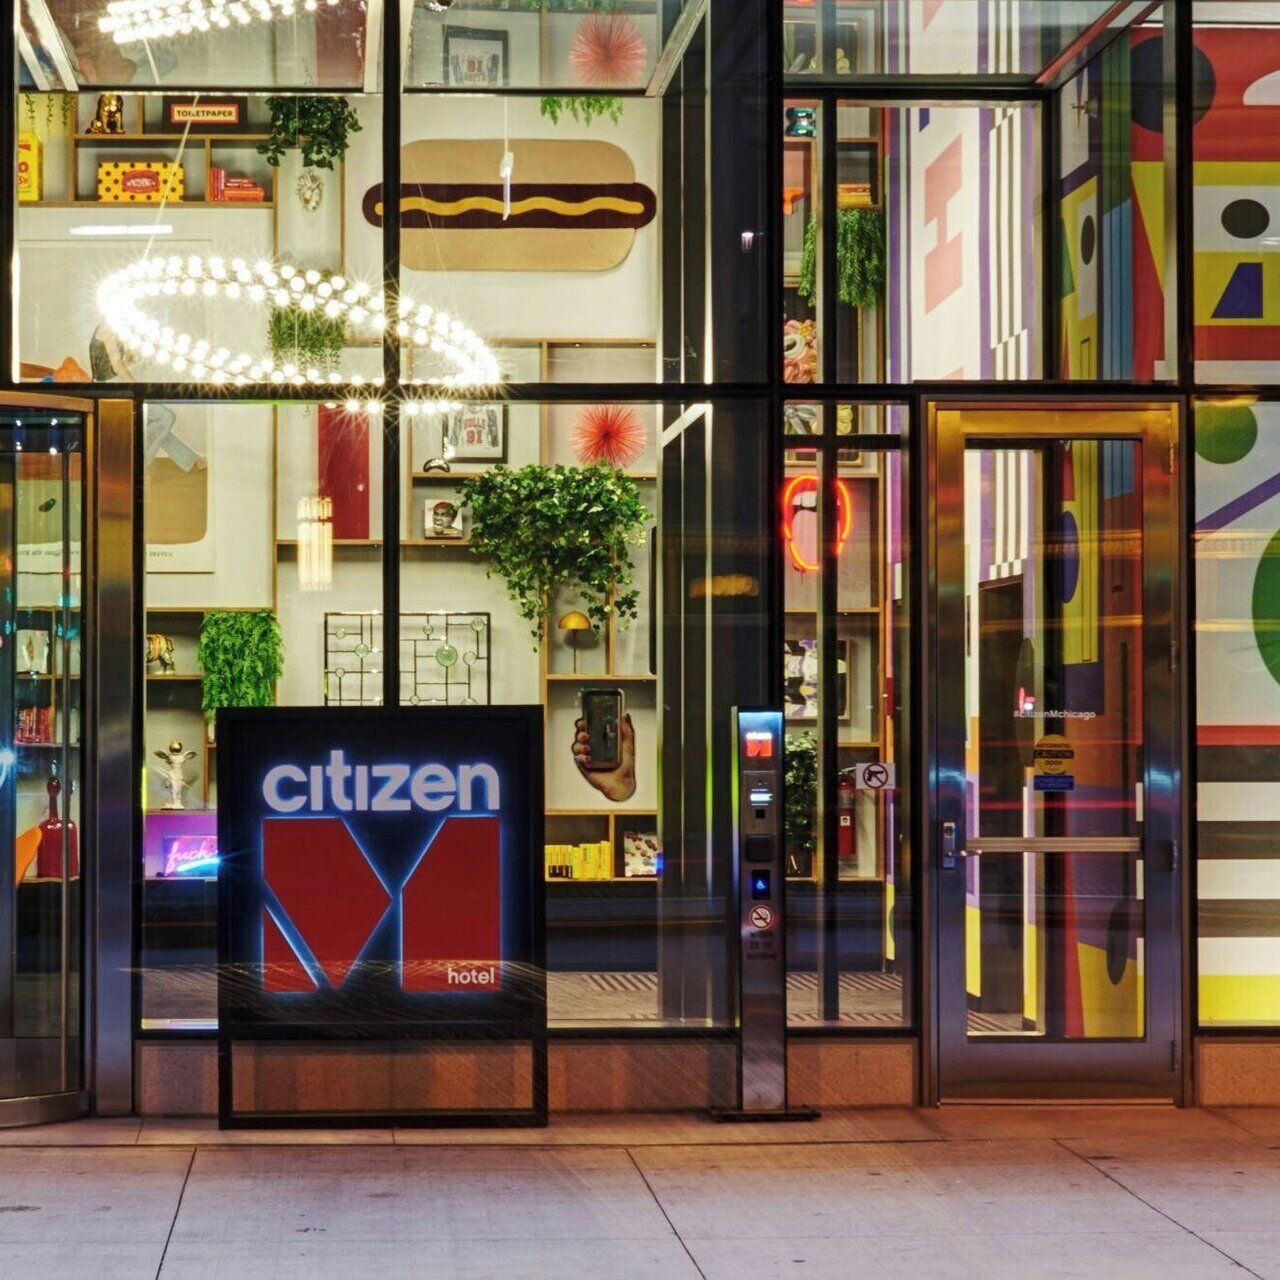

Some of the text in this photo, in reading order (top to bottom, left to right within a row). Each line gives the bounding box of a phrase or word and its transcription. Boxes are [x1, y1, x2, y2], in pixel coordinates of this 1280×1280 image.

[176, 109, 234, 117] TOILETPAPER
[466, 430, 483, 444] 91
[1035, 750, 1073, 758] CAUTION
[262, 749, 502, 813] citizen
[447, 966, 496, 986] hotel
